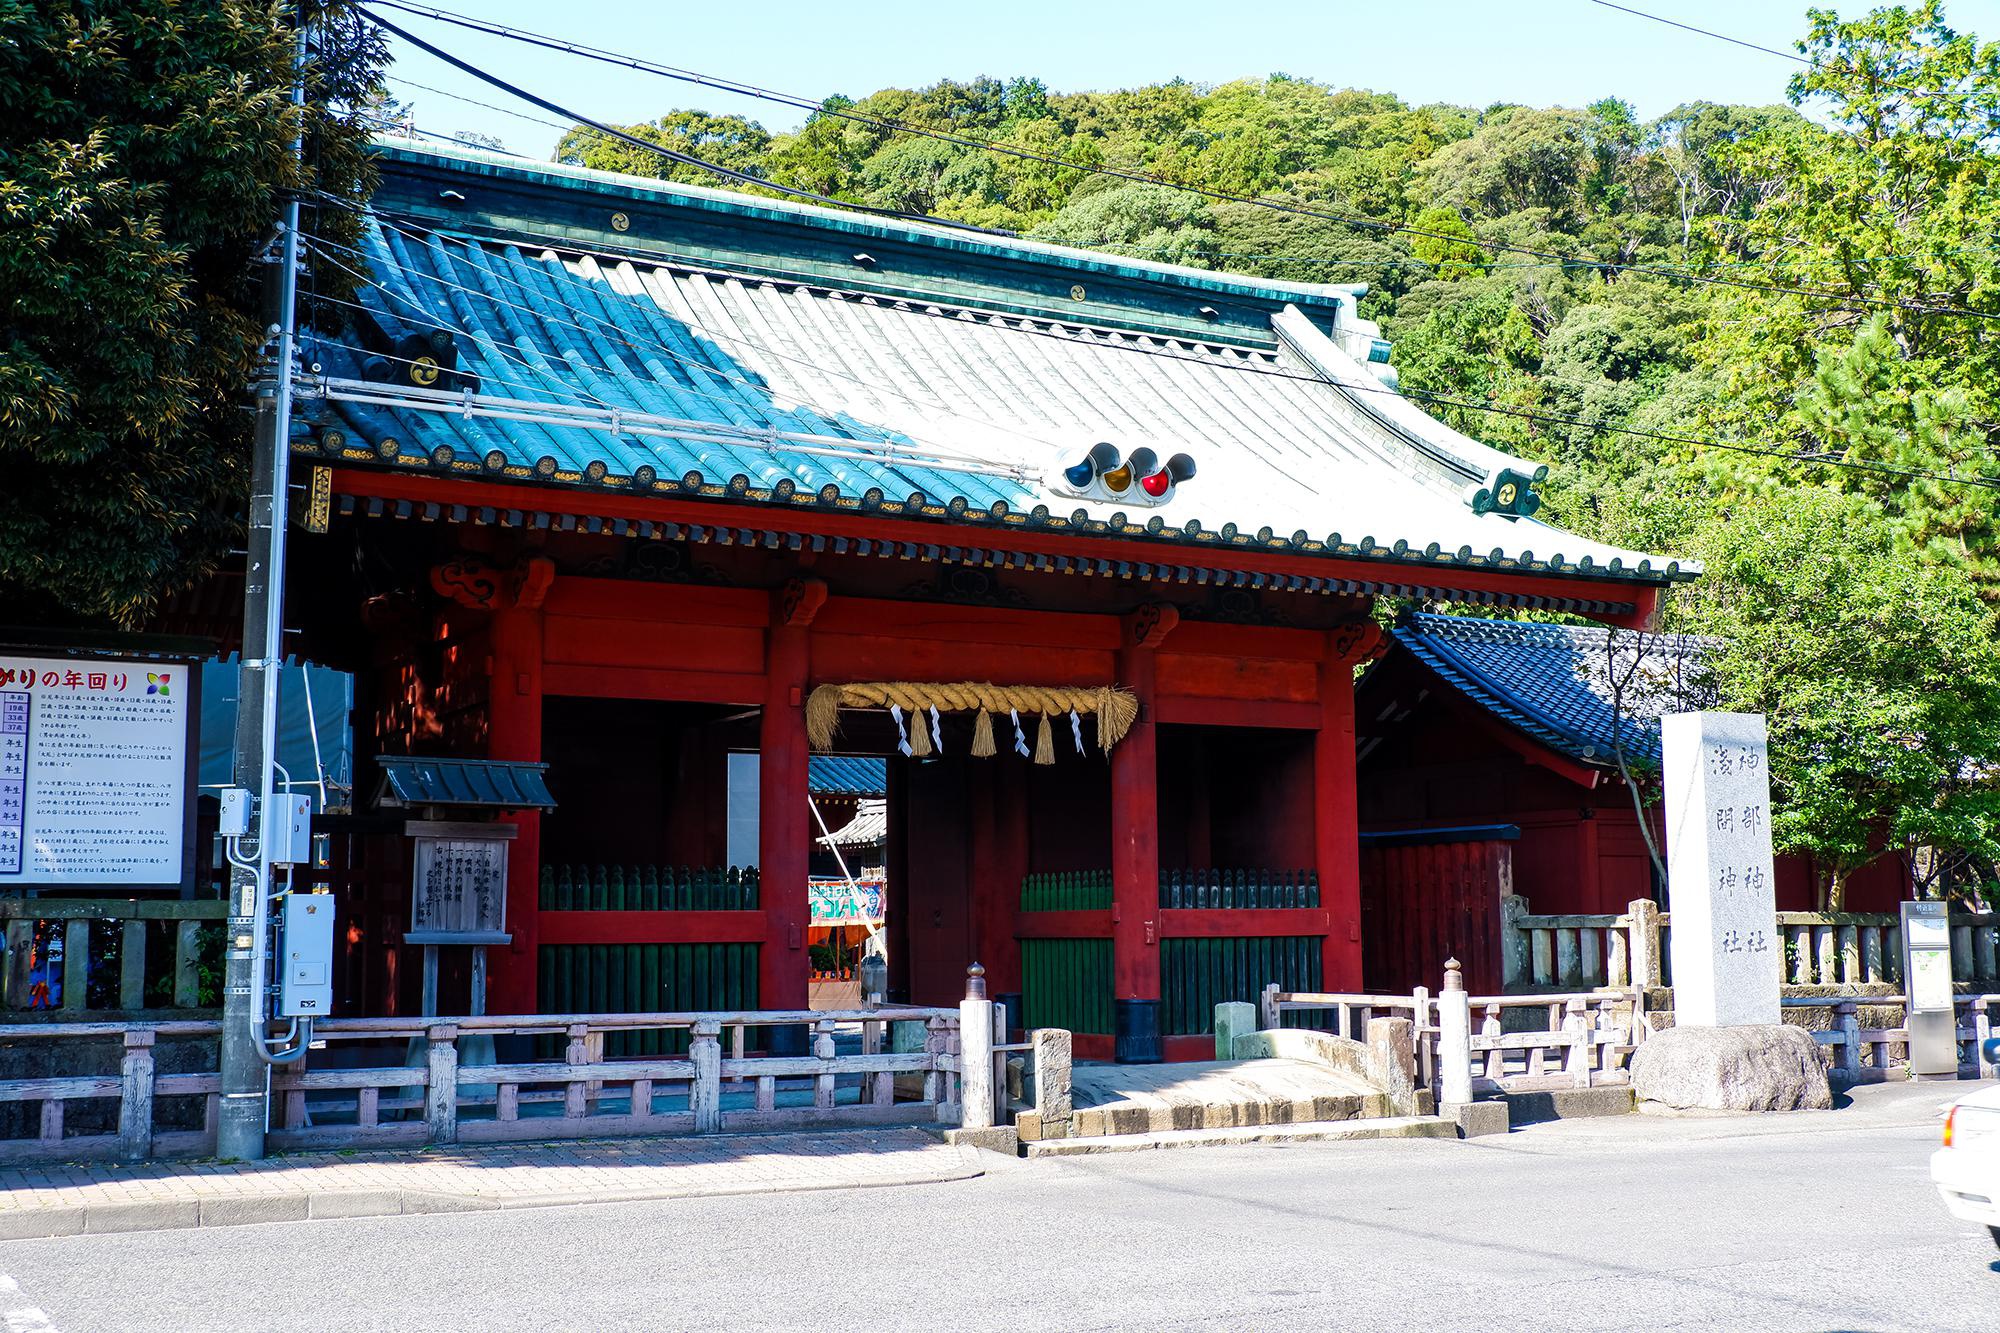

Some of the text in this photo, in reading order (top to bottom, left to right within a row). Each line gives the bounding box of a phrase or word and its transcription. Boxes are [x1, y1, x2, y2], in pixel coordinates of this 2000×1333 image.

[8, 704, 24, 712] 19歳
[7, 713, 24, 722] 33歳
[7, 723, 23, 732] 37歳
[1738, 745, 1768, 952] 神部神社
